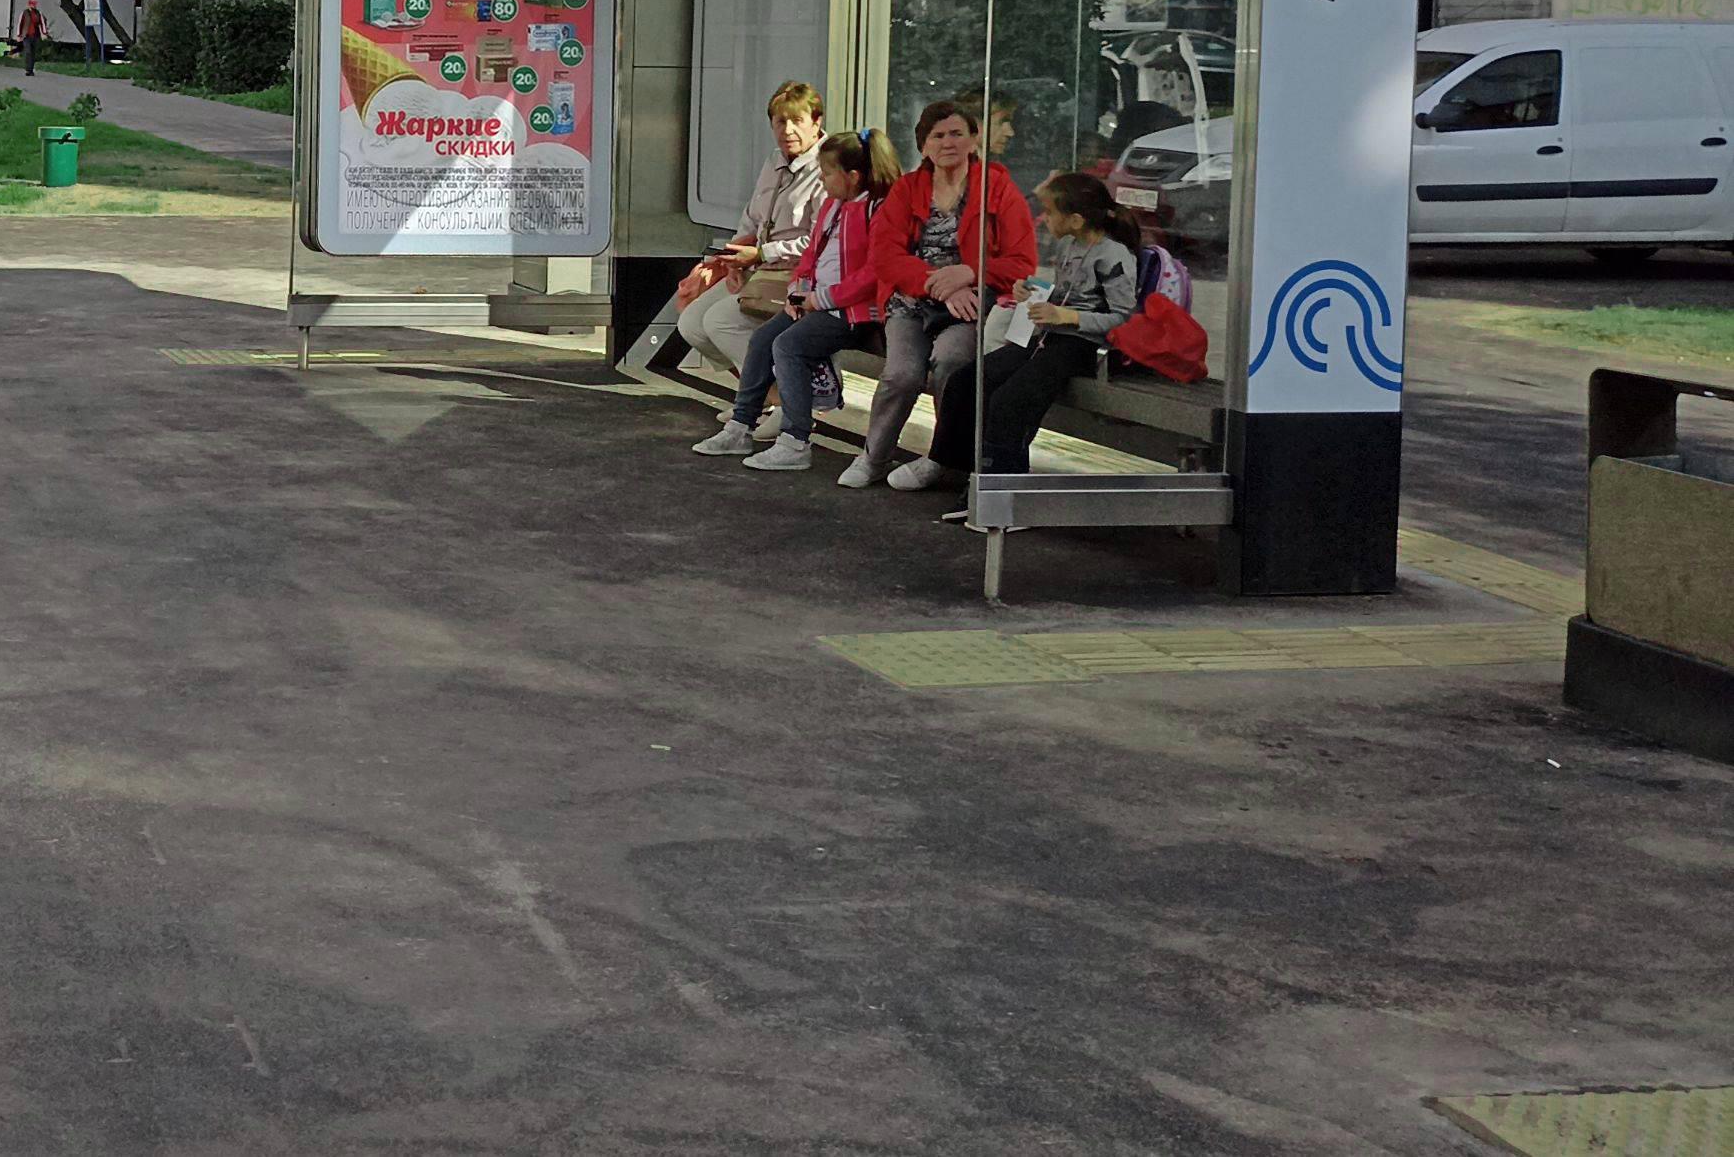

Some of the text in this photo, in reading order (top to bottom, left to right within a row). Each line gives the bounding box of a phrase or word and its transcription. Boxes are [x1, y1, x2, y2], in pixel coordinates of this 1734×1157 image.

[375, 111, 501, 141] Жаркие
[346, 190, 398, 208] ИМЕЮТСЯ
[515, 190, 585, 209] НЕОБХОДИМО
[346, 211, 410, 230] ПОЛУЧЕНИЕ
